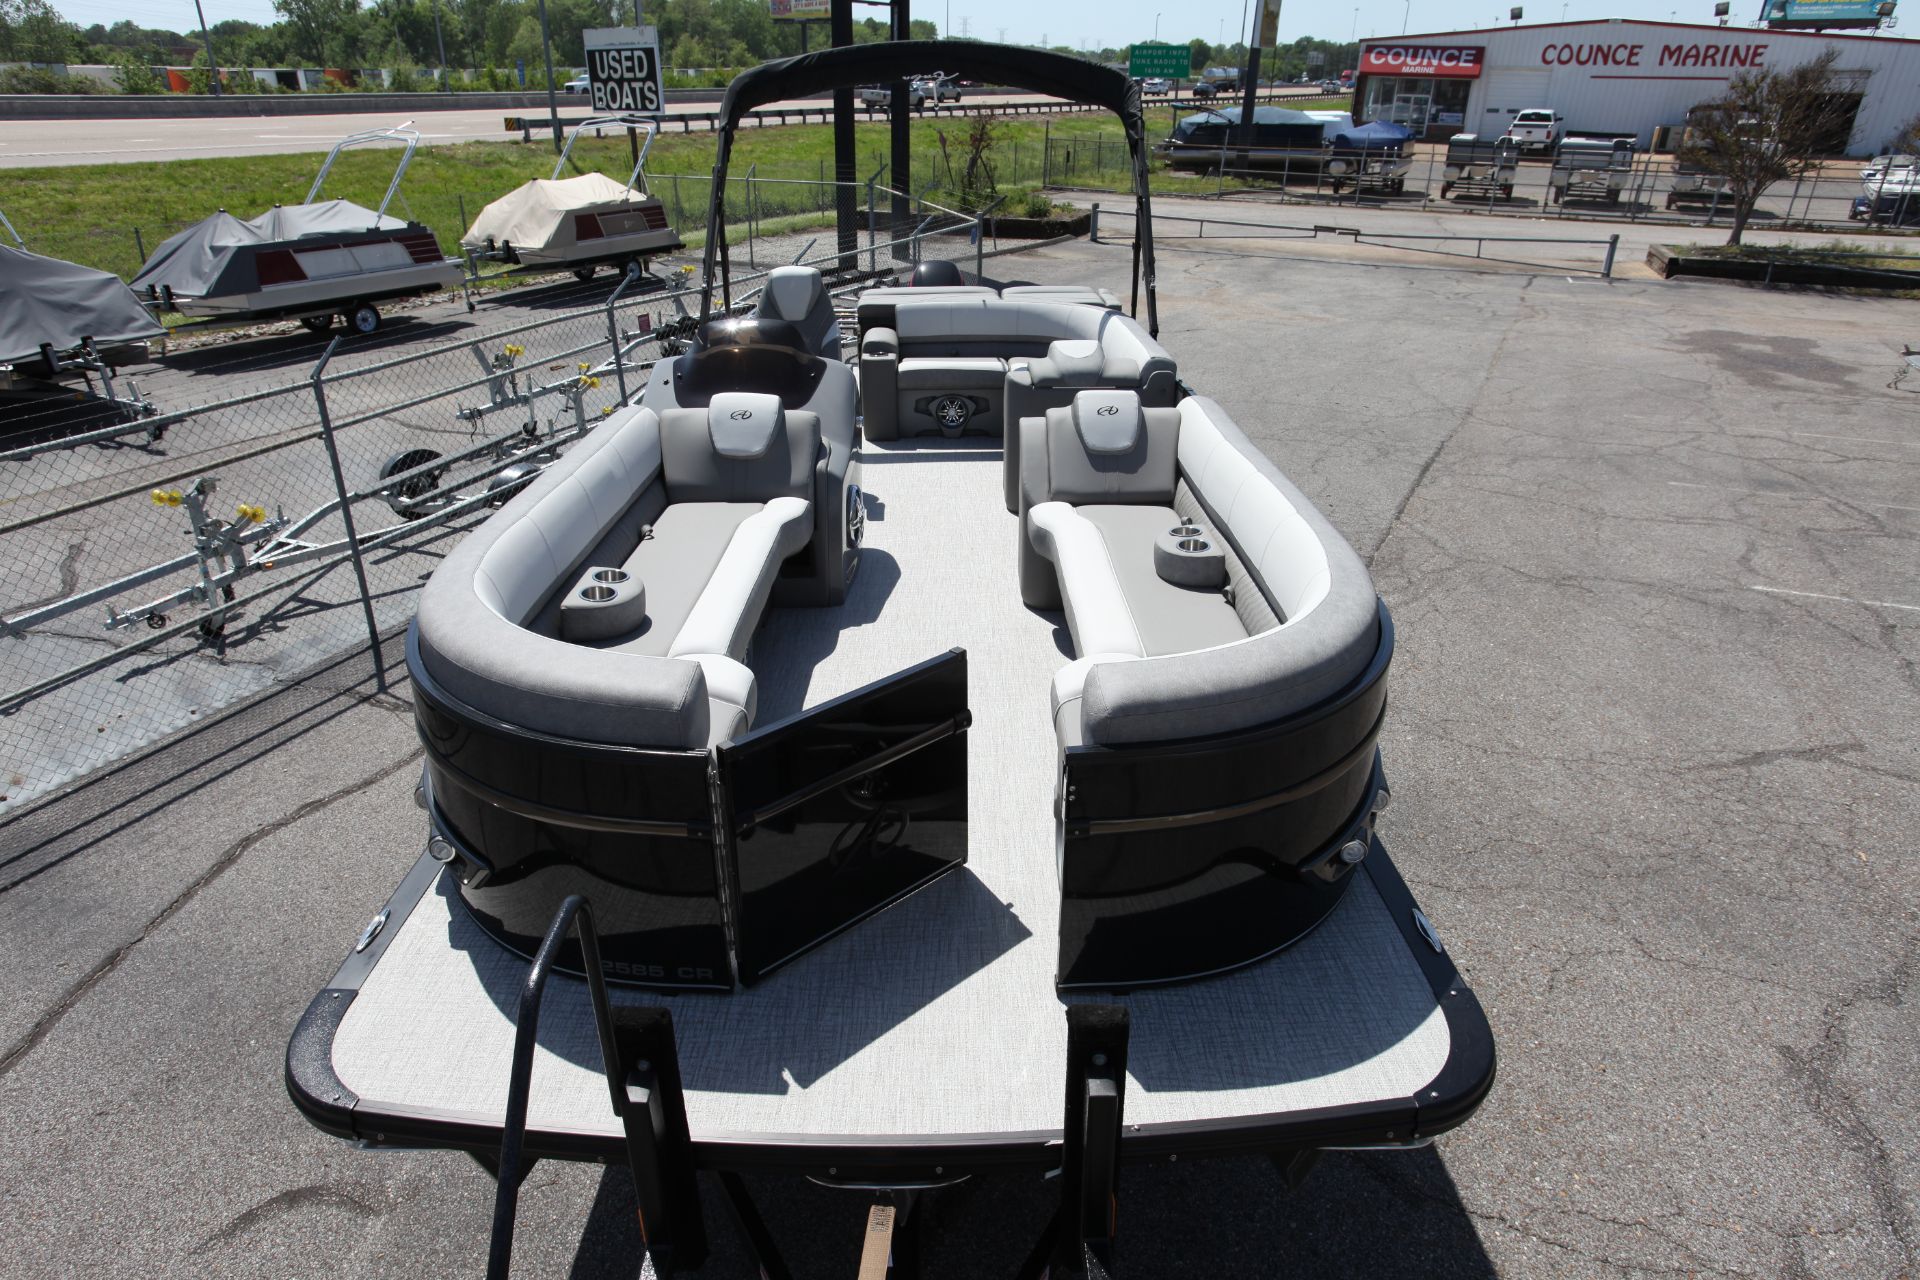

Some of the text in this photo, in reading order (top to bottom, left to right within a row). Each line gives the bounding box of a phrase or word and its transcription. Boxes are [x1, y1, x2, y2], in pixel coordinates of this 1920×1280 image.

[595, 50, 648, 79] USED
[1369, 47, 1477, 67] COUNCE
[1541, 43, 1769, 67] COUNCE MARINE
[1401, 66, 1435, 74] MARINE
[592, 81, 658, 110] BOATS
[601, 959, 713, 980] 2585 CR
